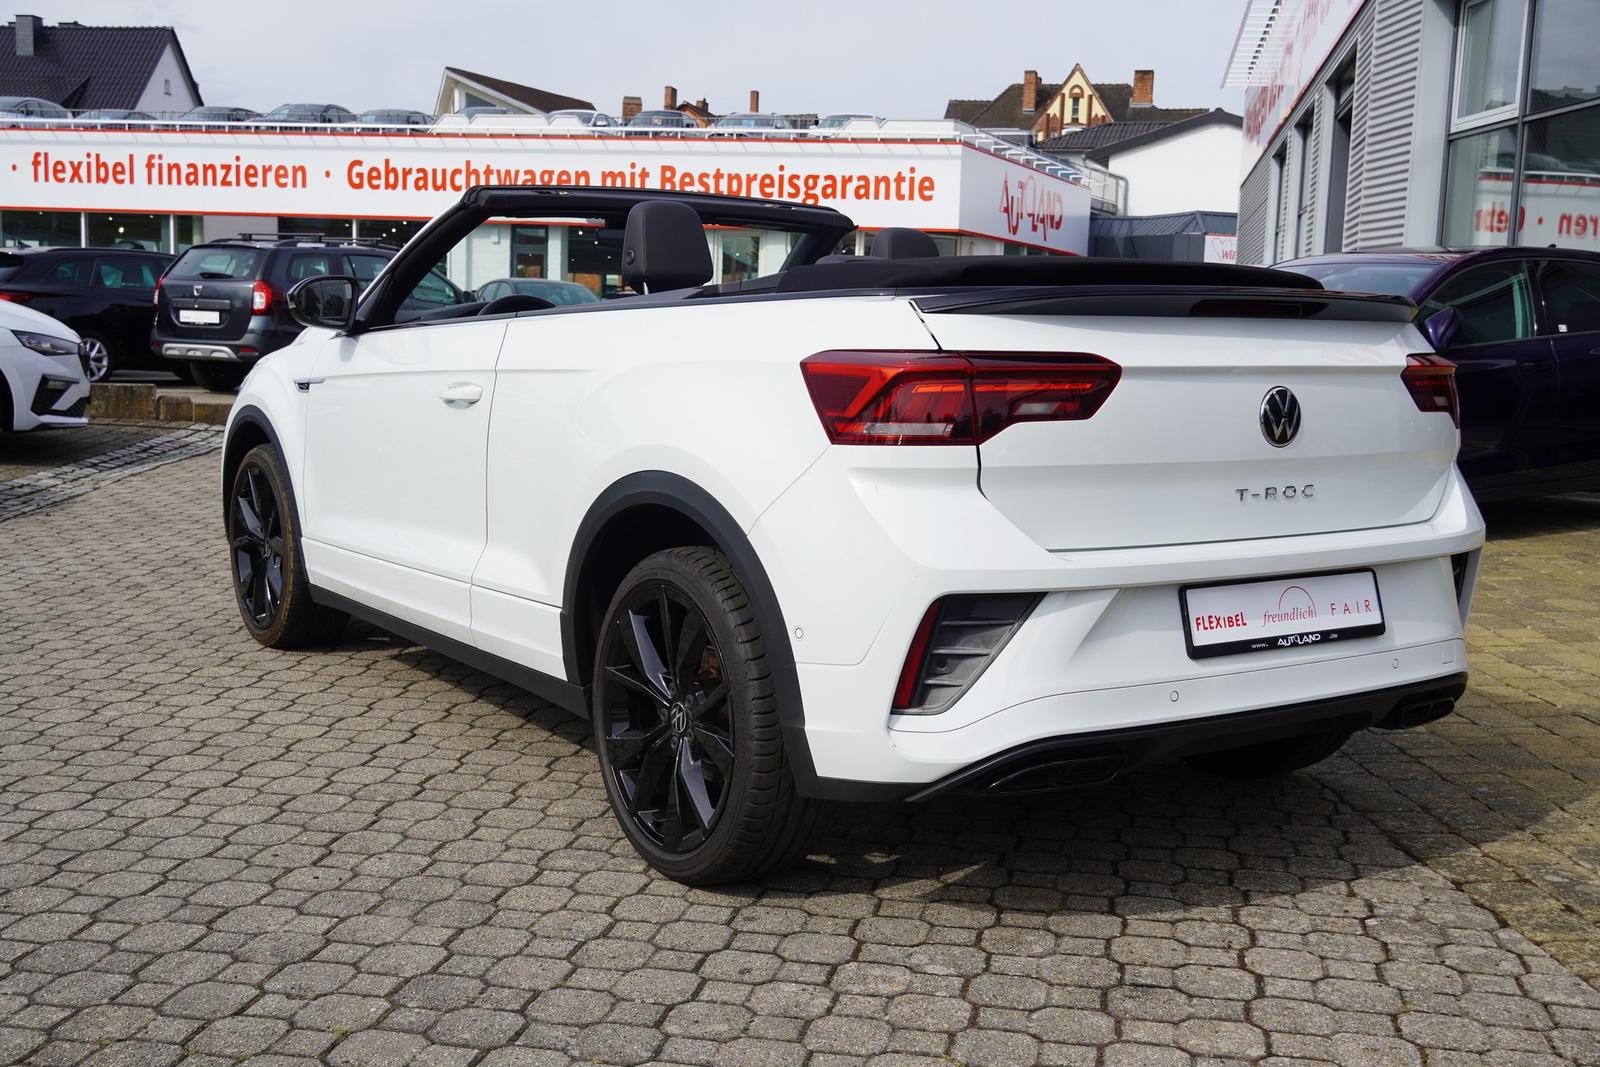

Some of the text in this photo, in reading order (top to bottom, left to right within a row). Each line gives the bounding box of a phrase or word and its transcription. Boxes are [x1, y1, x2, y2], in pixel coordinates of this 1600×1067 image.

[31, 151, 308, 189] flexibel finanzieren
[346, 158, 936, 207] Gebrauchtwagen mit Bestpreisgarantie
[1236, 484, 1315, 502] T-ROC
[1195, 599, 1372, 632] FLEXIBEL freundlich FAIR
